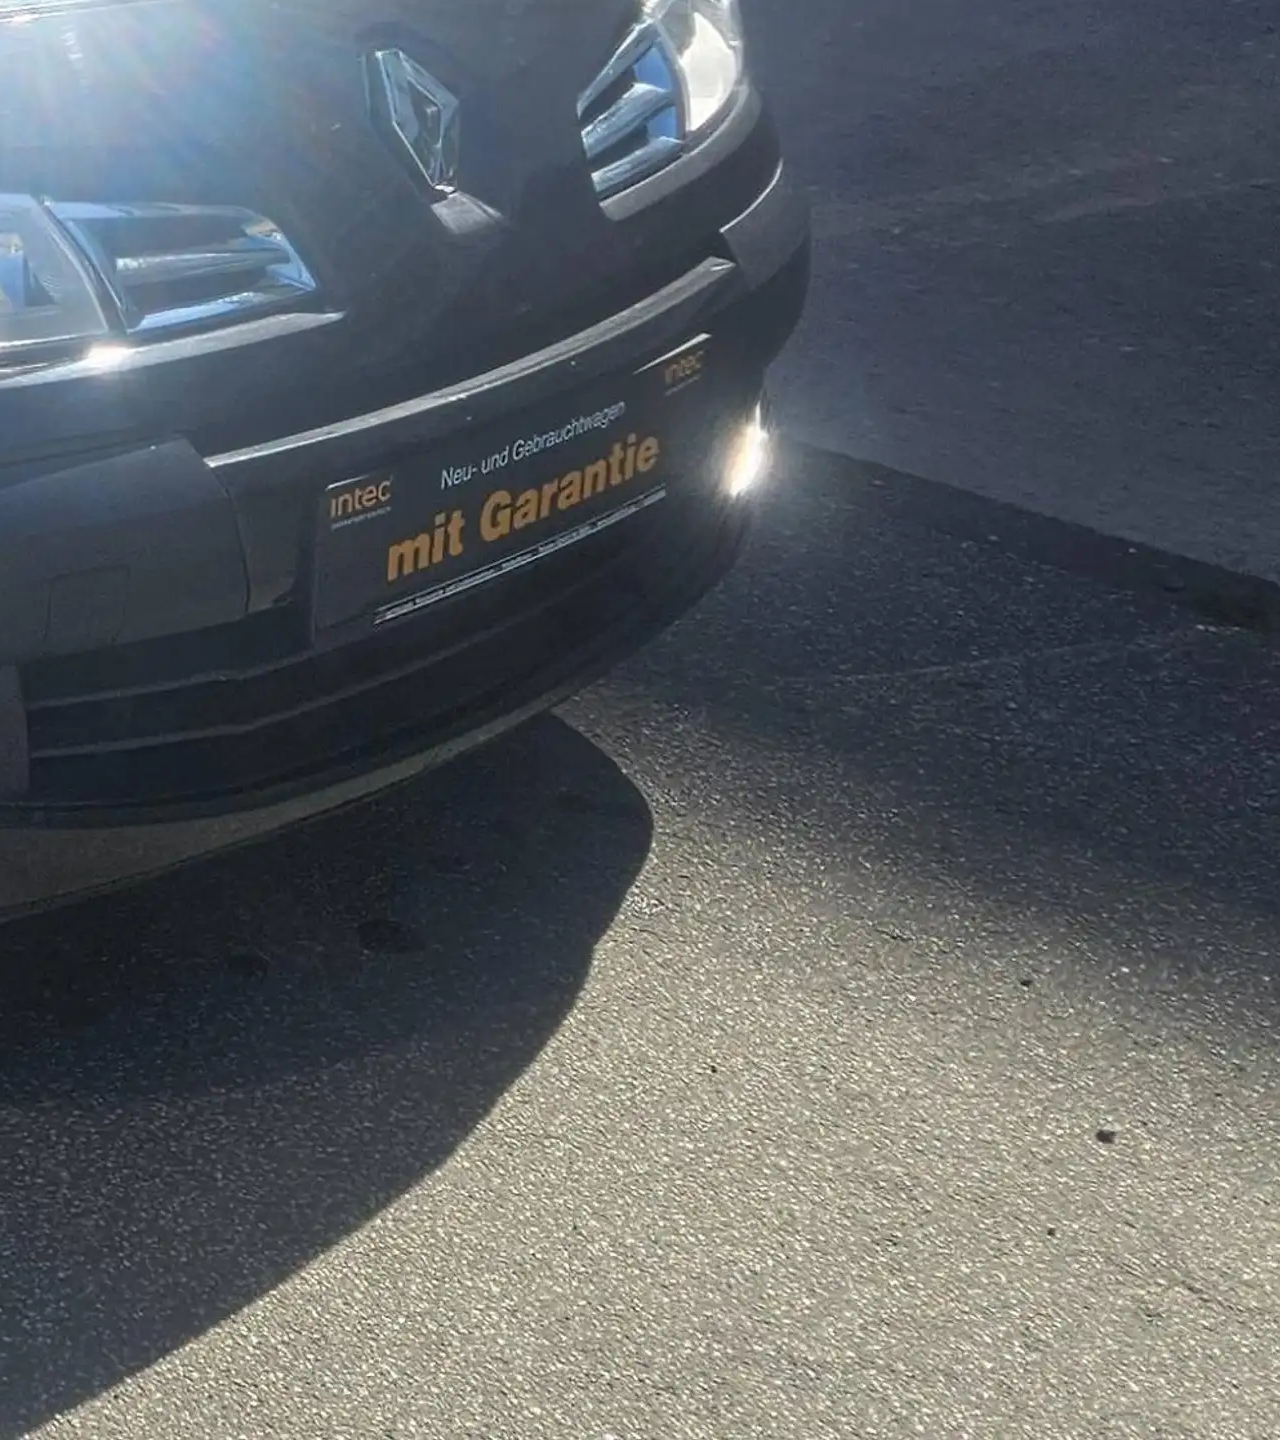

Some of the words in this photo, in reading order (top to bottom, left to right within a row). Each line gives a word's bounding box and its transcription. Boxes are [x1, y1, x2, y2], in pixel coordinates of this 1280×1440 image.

[441, 464, 477, 490] Neu-
[480, 446, 510, 474] und
[512, 401, 626, 461] Gebrauchtwagen
[386, 512, 465, 582] mit
[479, 432, 660, 542] Garantie
